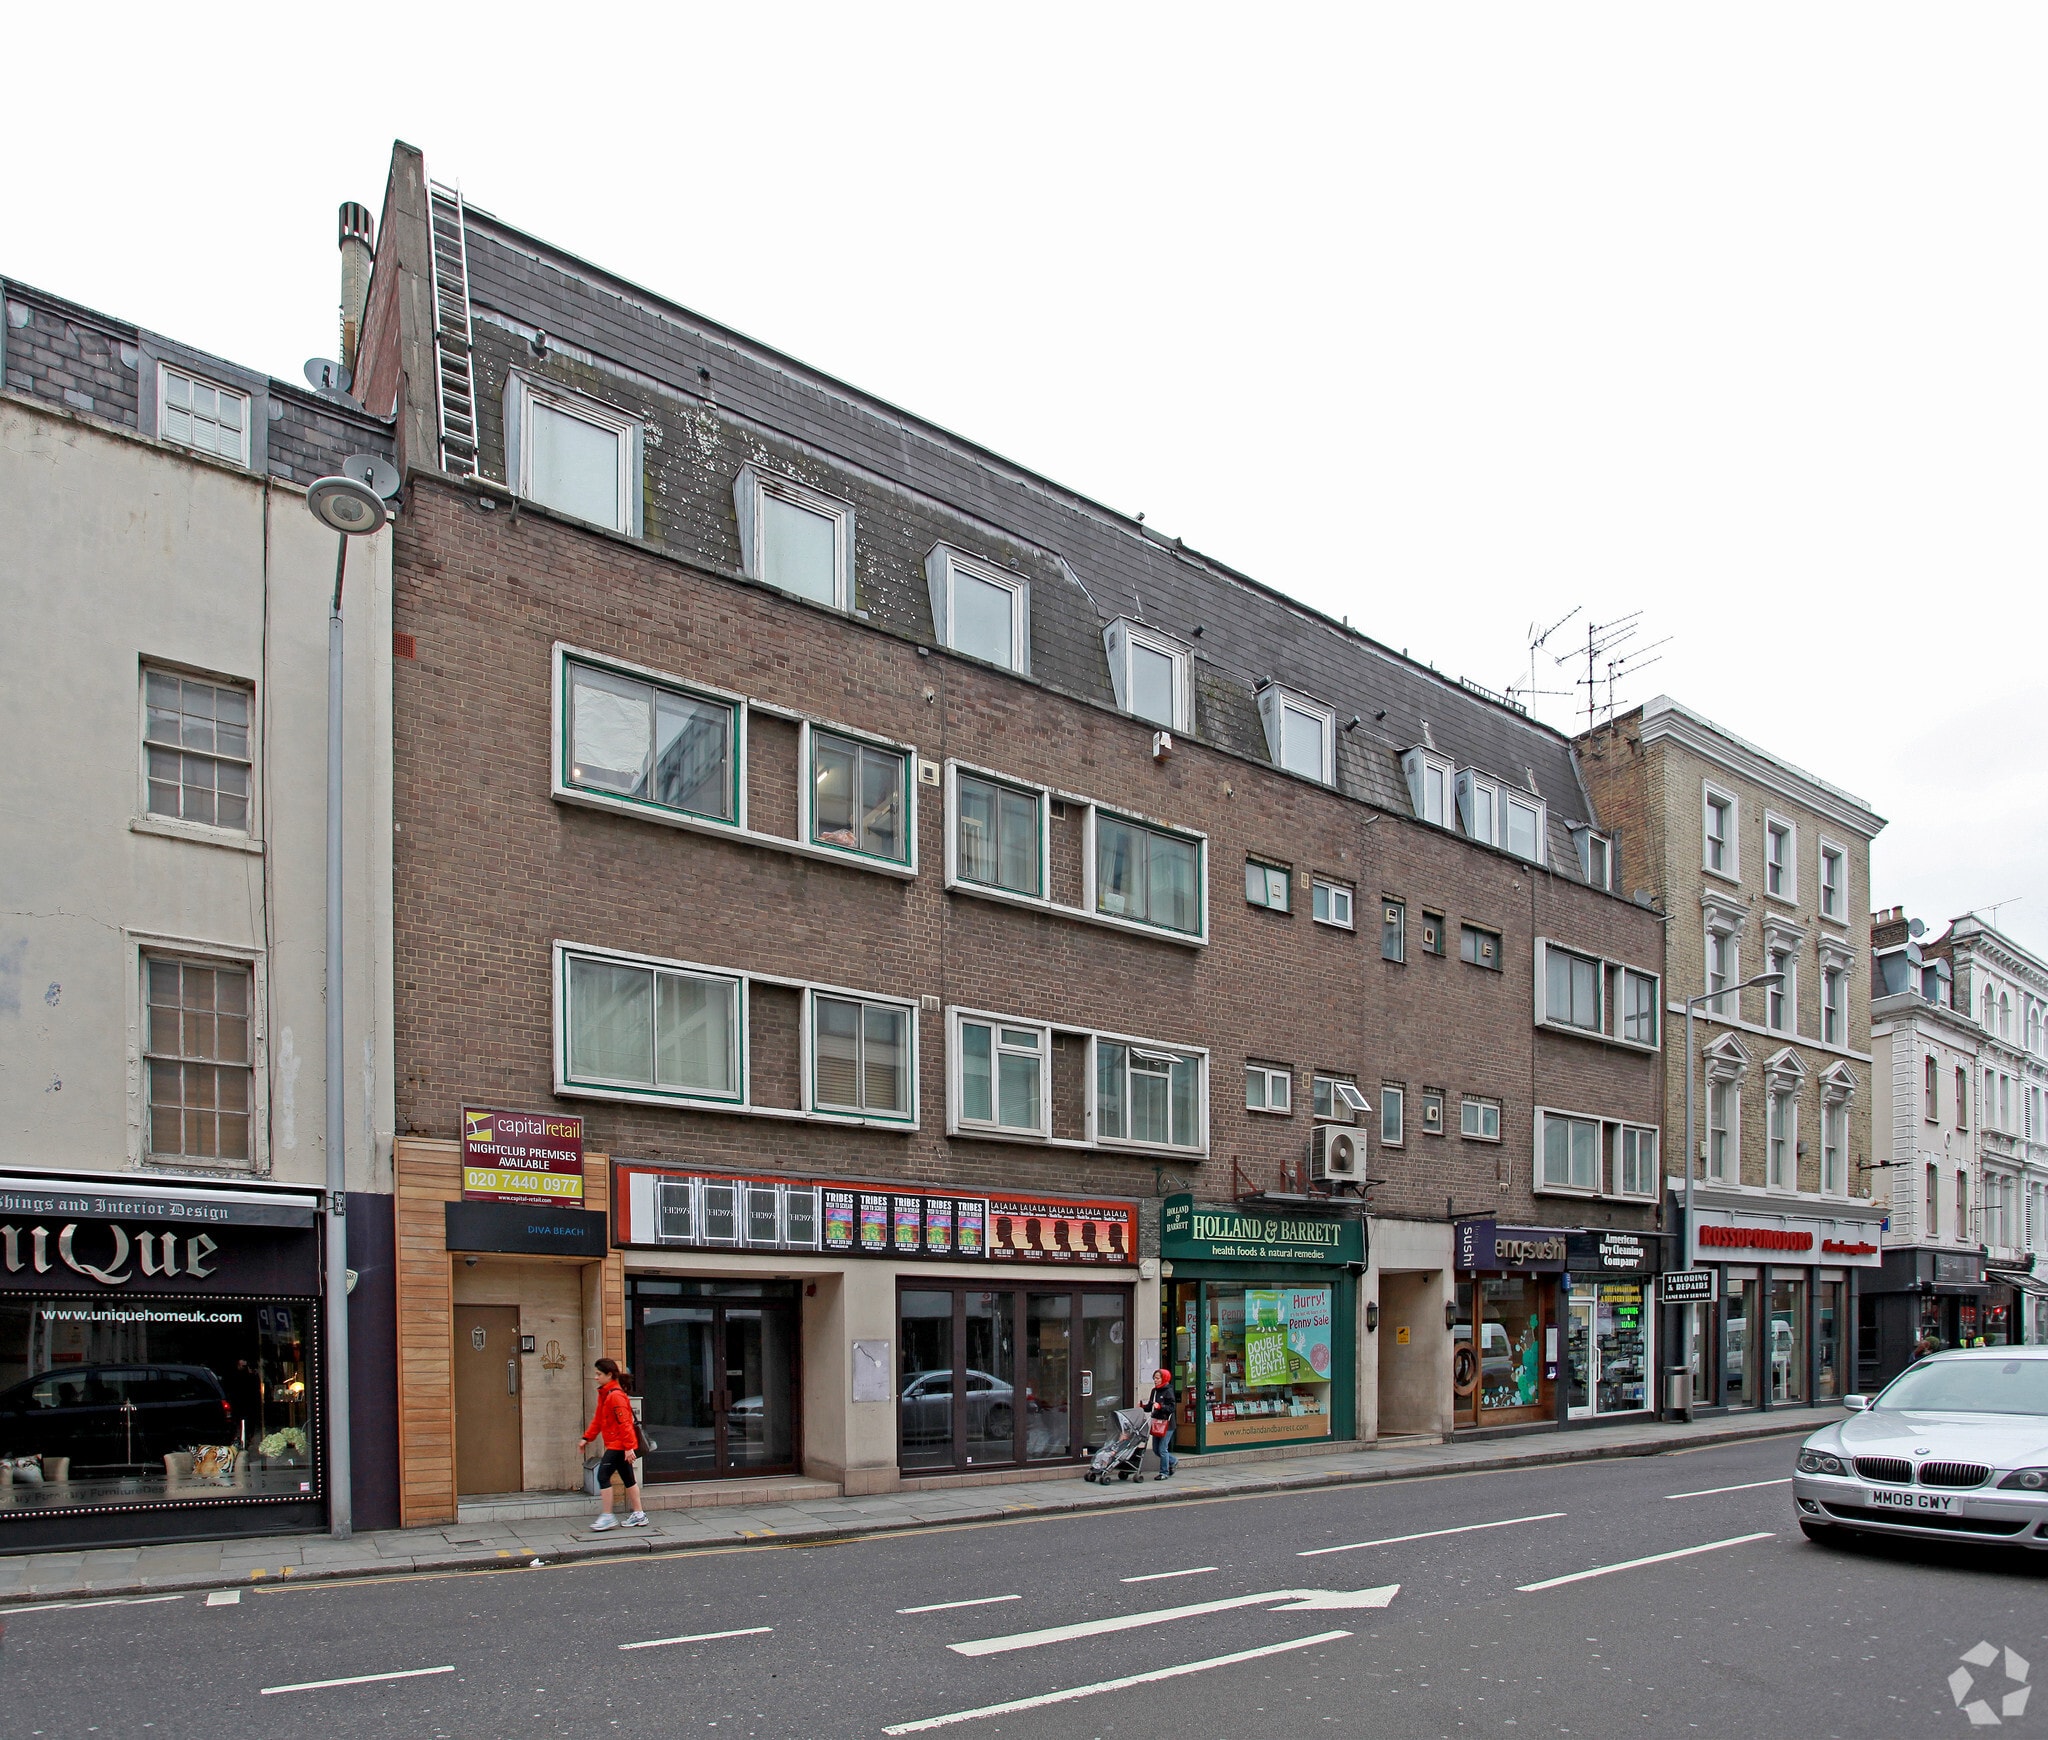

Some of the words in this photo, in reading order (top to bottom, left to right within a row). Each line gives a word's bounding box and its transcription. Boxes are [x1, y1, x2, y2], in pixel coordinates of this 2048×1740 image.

[469, 1143, 526, 1157] NIGHTCLUB
[529, 1148, 577, 1162] PREMISES
[498, 1157, 550, 1170] AVAILABLE
[468, 1172, 497, 1187] 020
[501, 1174, 538, 1190] 7440
[543, 1177, 578, 1193] 0977
[498, 1195, 552, 1203] www.capital-retail.com
[825, 1192, 853, 1204] TRIBES
[860, 1194, 888, 1206] TRIBES
[894, 1197, 920, 1208] TRIBES
[58, 1199, 89, 1212] and
[95, 1198, 165, 1215] Interior
[169, 1202, 229, 1221] Design
[927, 1199, 952, 1210] TRIBES
[958, 1201, 983, 1212] TRIBES
[991, 1201, 999, 1209] LA
[1000, 1202, 1008, 1210] LA
[1020, 1203, 1028, 1211] LA
[1058, 1206, 1065, 1214] LA
[1076, 1207, 1084, 1215] LA
[1166, 1205, 1189, 1217] HOLLAND
[527, 1225, 551, 1234] DIVA
[553, 1226, 584, 1236] BEACH
[1166, 1221, 1189, 1233] BARRETT
[1192, 1215, 1261, 1240] HOLLAND
[1264, 1219, 1278, 1244] &
[1281, 1220, 1341, 1247] BARRETT
[1605, 1233, 1639, 1245] American
[1699, 1225, 1814, 1251] ROSSOPOMODORO
[1212, 1245, 1236, 1256] health
[1237, 1247, 1258, 1257] foods
[1259, 1248, 1266, 1257] &
[1268, 1249, 1292, 1258] natural
[1294, 1251, 1325, 1259] remedies
[1463, 1226, 1475, 1267] sushi
[1599, 1244, 1612, 1256] Dry
[1613, 1244, 1644, 1257] Cleaning
[1603, 1255, 1639, 1267] Company
[1668, 1274, 1709, 1284] TAILORING
[1676, 1282, 1708, 1290] REPAIRS
[1293, 1291, 1325, 1309] Hurry!
[41, 1308, 243, 1324] www.uniquehomeuk.com
[1289, 1318, 1311, 1330] Penny
[1313, 1315, 1329, 1327] Sale
[1248, 1334, 1283, 1355] DOUBLE
[1249, 1347, 1283, 1367] POINTS
[1251, 1357, 1286, 1379] EVENT!!
[1873, 1490, 1913, 1507] MM08
[1918, 1496, 1951, 1509] GWY
